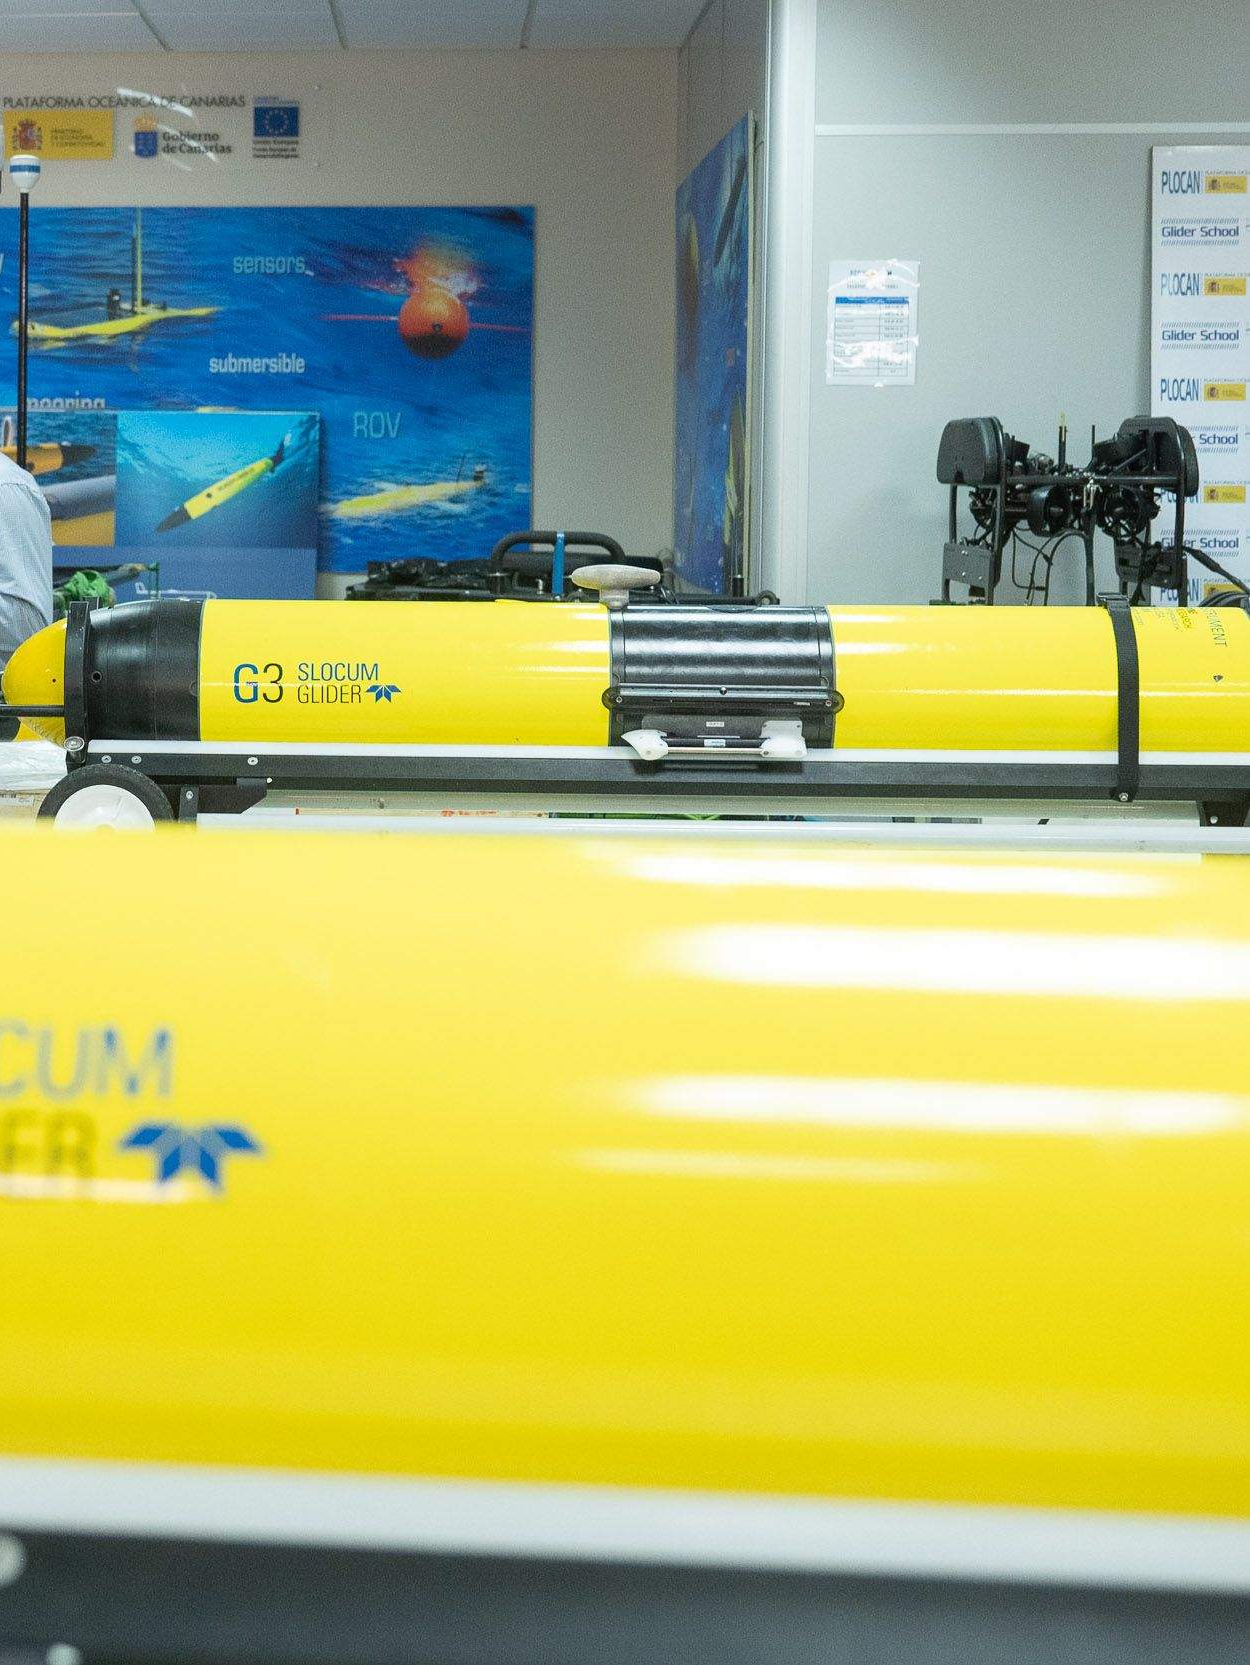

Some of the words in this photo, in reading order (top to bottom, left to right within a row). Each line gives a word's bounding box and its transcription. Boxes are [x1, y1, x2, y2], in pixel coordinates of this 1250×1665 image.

[3, 96, 84, 108] PLATAFORMA
[180, 95, 246, 107] CANARIAS
[162, 131, 220, 142] Gobierno
[162, 143, 177, 154] de
[1161, 170, 1200, 194] PLOCAN
[1161, 226, 1196, 237] Glider
[1200, 226, 1239, 237] School
[233, 256, 306, 274] sensors
[1160, 272, 1200, 296] PLOCAN
[1162, 329, 1196, 341] Glider
[1200, 329, 1239, 341] School
[209, 351, 306, 374] submersible
[1160, 378, 1199, 402] PLOCAN
[353, 411, 400, 438] ROV
[1199, 433, 1238, 445] School
[1161, 537, 1197, 548] Glier
[1200, 537, 1239, 548] School
[298, 663, 379, 681] SLOCUM
[233, 663, 285, 704] G3
[298, 684, 362, 704] GLIDER
